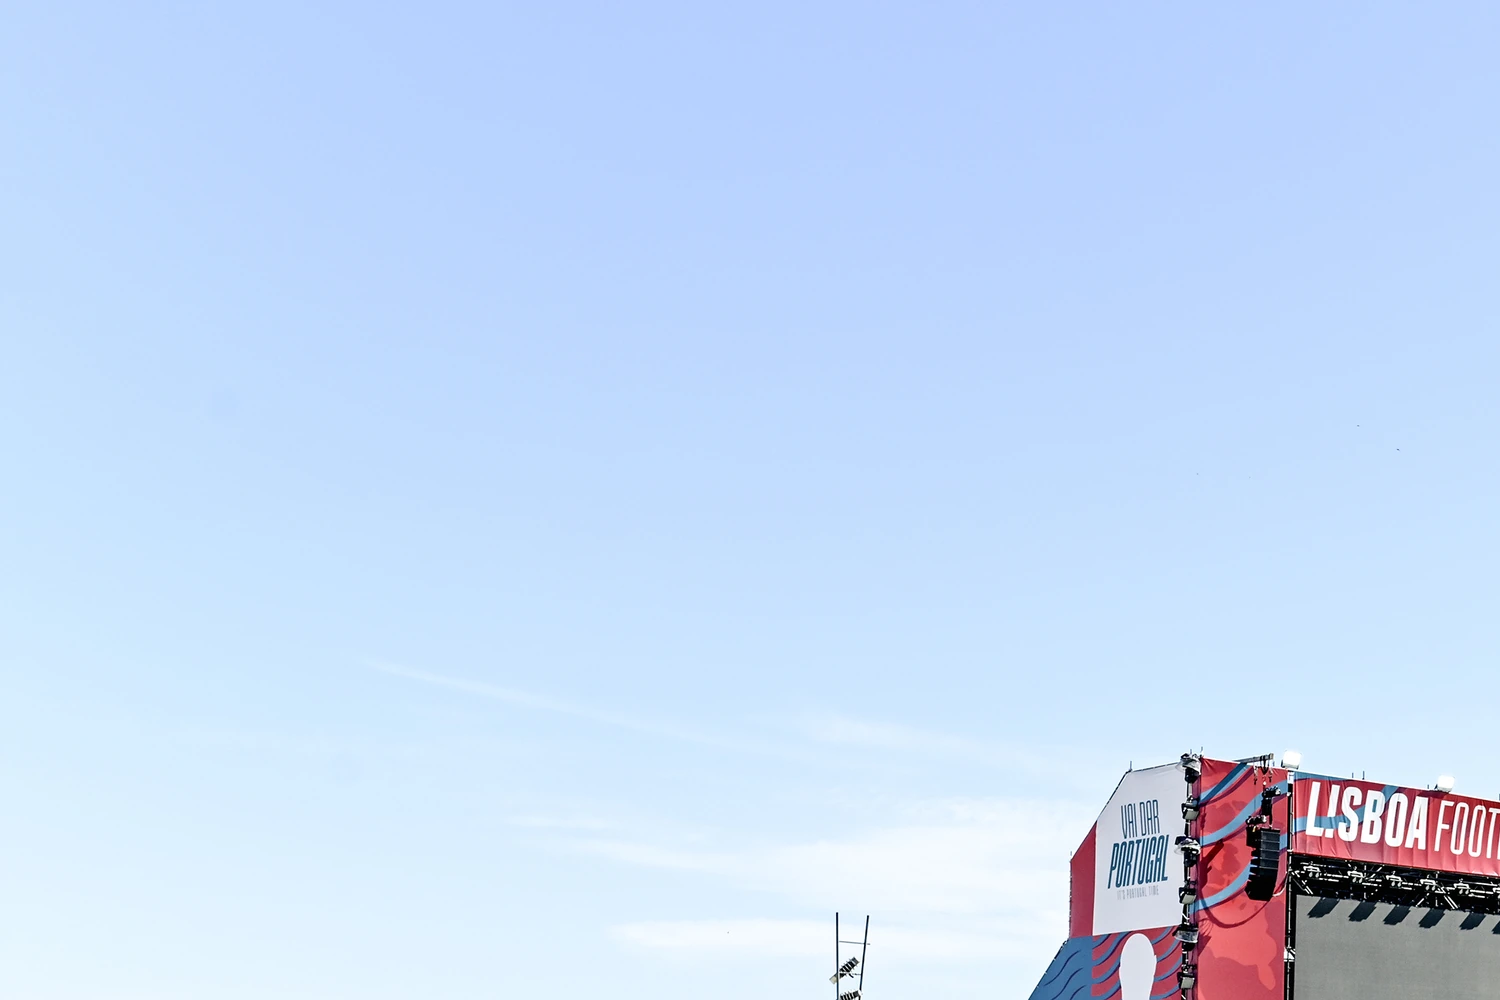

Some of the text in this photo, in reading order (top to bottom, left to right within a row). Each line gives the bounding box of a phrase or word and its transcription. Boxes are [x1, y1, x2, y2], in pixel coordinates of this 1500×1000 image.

[1121, 799, 1160, 839] VAI DAR
[1306, 781, 1427, 850] LISBOA
[1107, 834, 1169, 889] PORTUGAL
